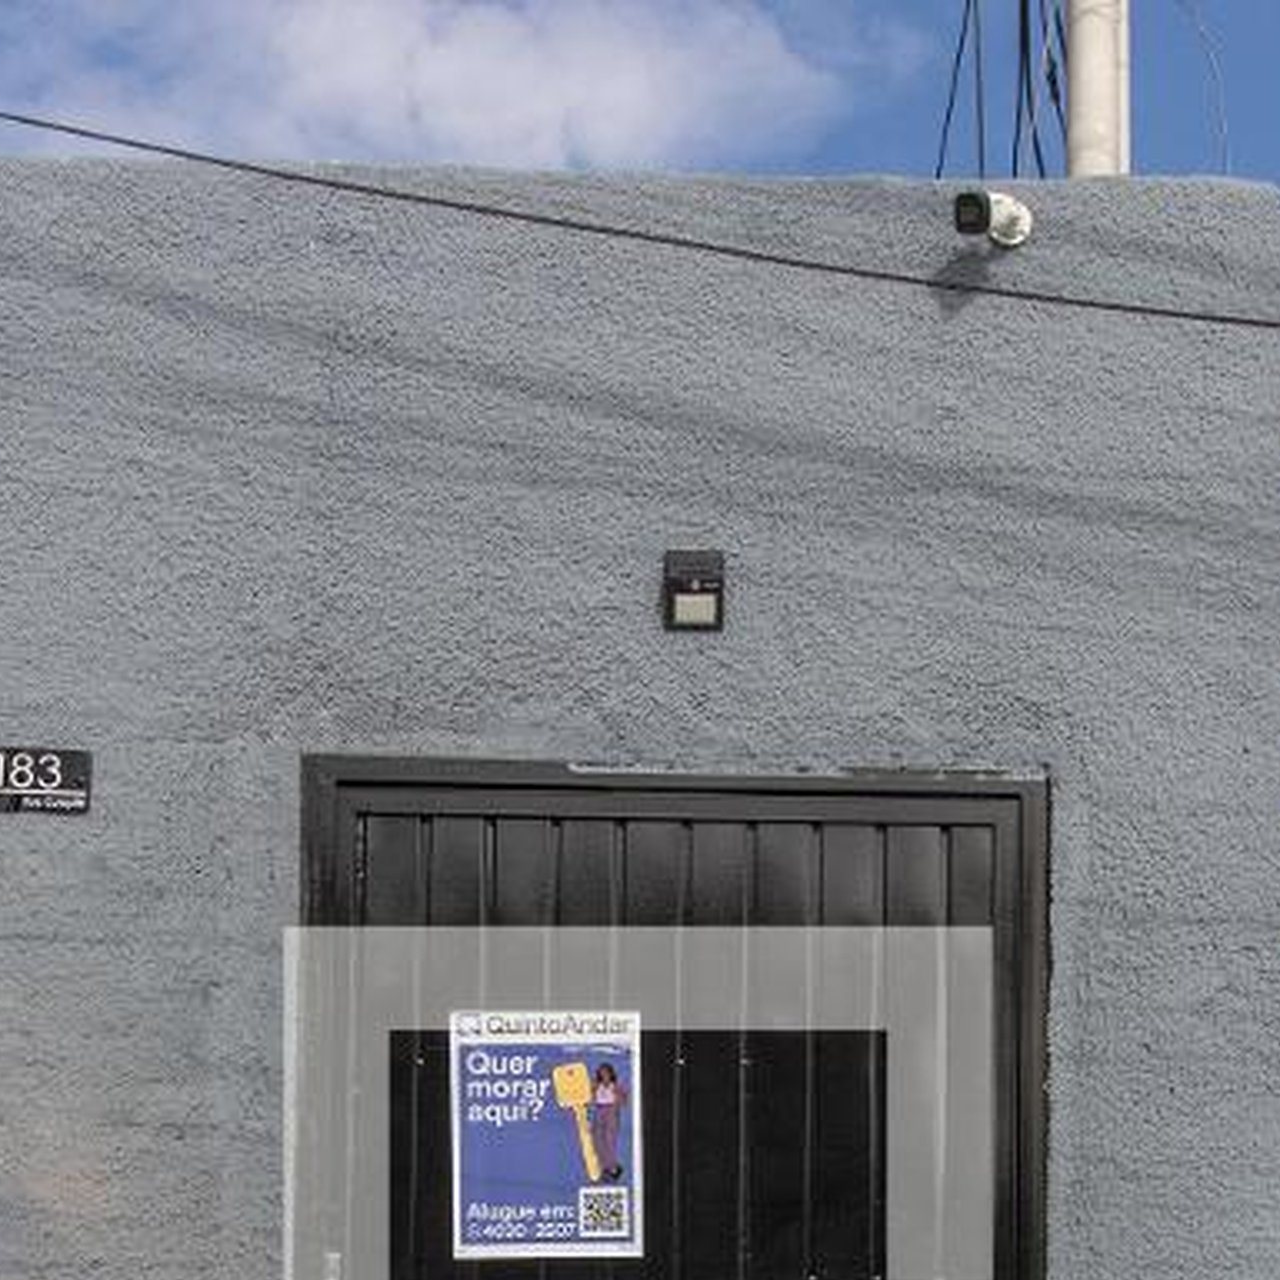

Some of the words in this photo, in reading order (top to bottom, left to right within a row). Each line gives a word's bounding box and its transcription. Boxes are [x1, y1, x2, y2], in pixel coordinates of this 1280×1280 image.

[486, 1014, 628, 1036] QuintoAndar
[466, 1051, 539, 1075] Quer
[466, 1079, 551, 1098] morar
[468, 1098, 544, 1127] aqui?
